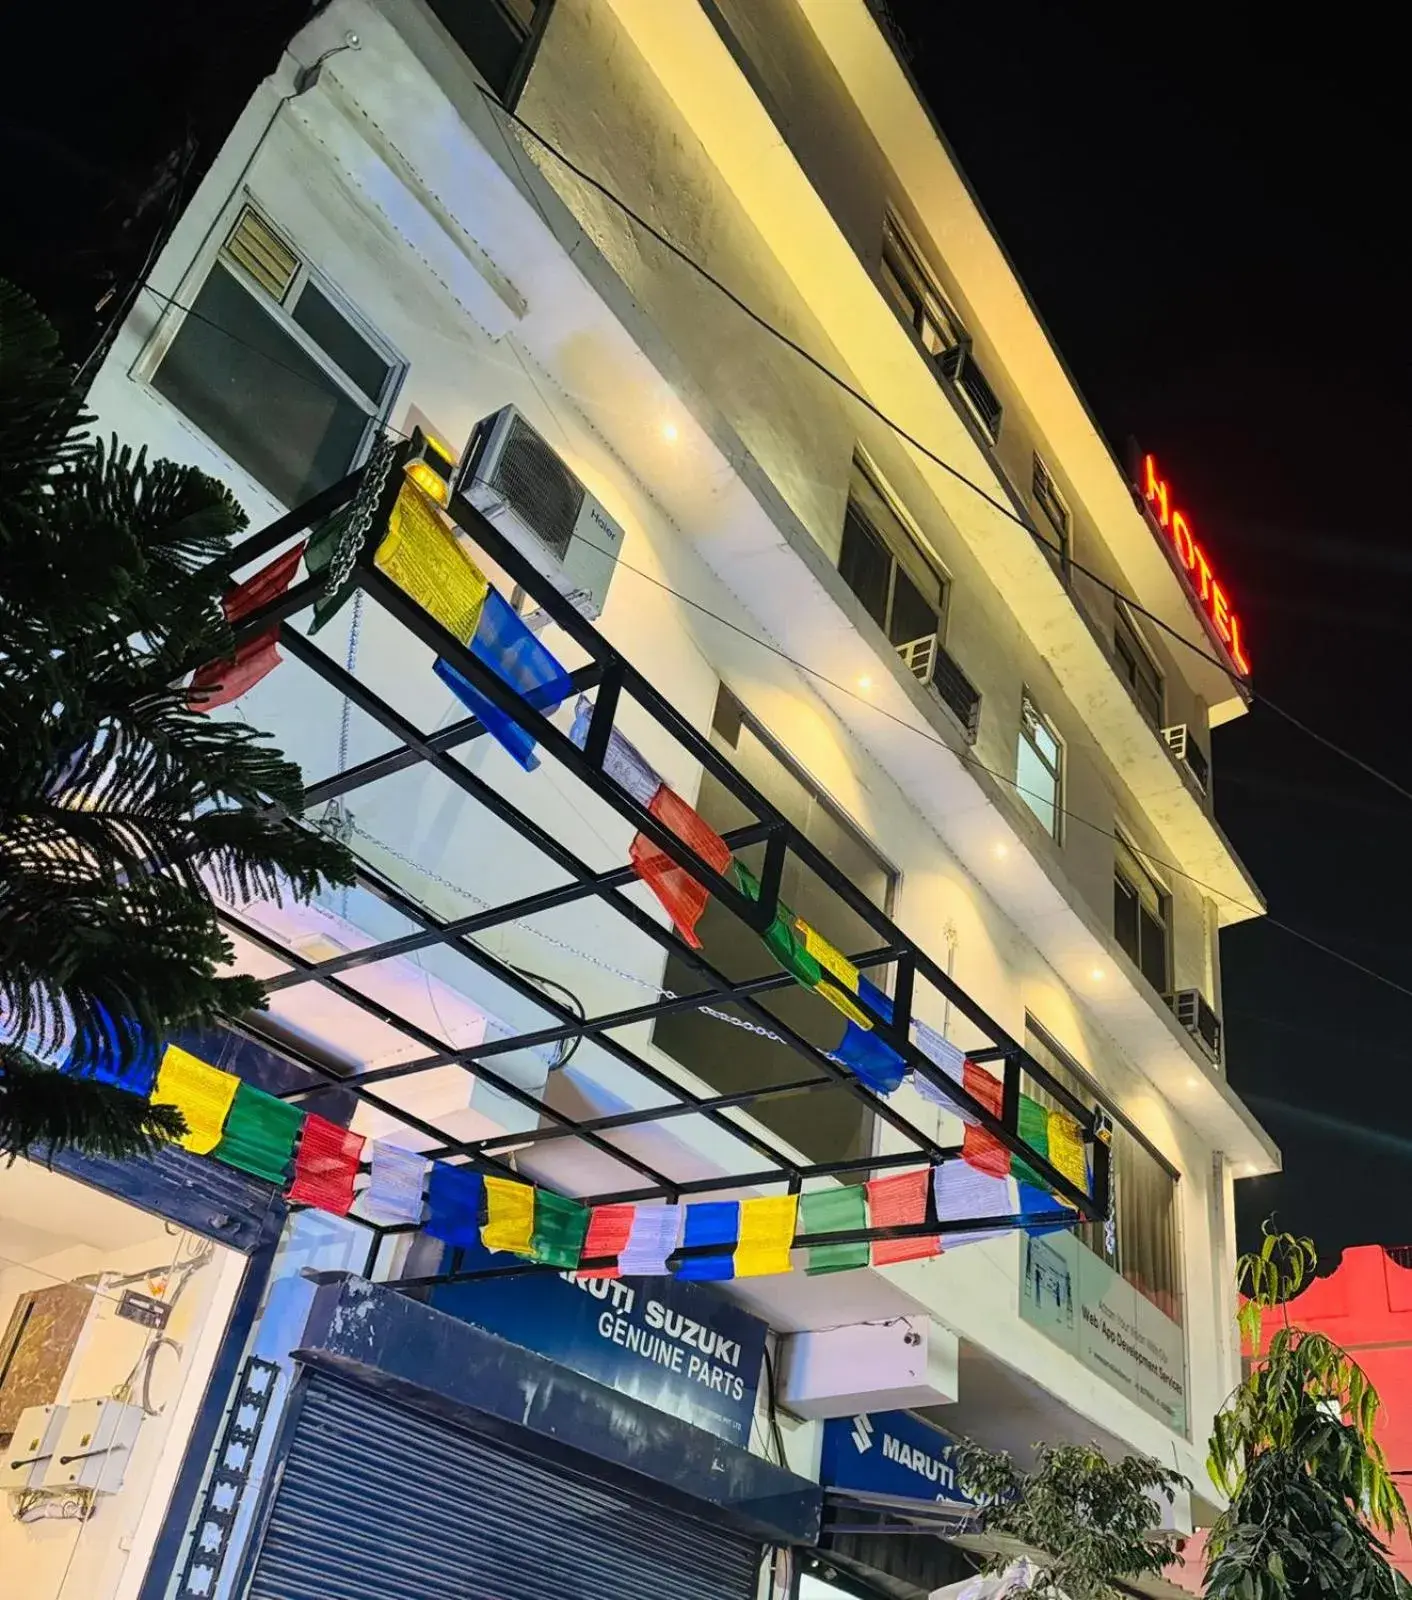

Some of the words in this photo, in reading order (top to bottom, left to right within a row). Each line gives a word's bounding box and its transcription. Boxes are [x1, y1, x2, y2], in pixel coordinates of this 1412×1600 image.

[590, 508, 617, 541] Haier
[1146, 454, 1249, 675] HOTEL
[598, 1312, 685, 1373] GENUINE
[688, 1355, 744, 1401] PARTS
[645, 1300, 741, 1368] SUZUKI
[1102, 1321, 1116, 1344] App
[1117, 1332, 1158, 1376] Development
[1159, 1366, 1183, 1396] Services
[882, 1433, 954, 1490] MARUTI
